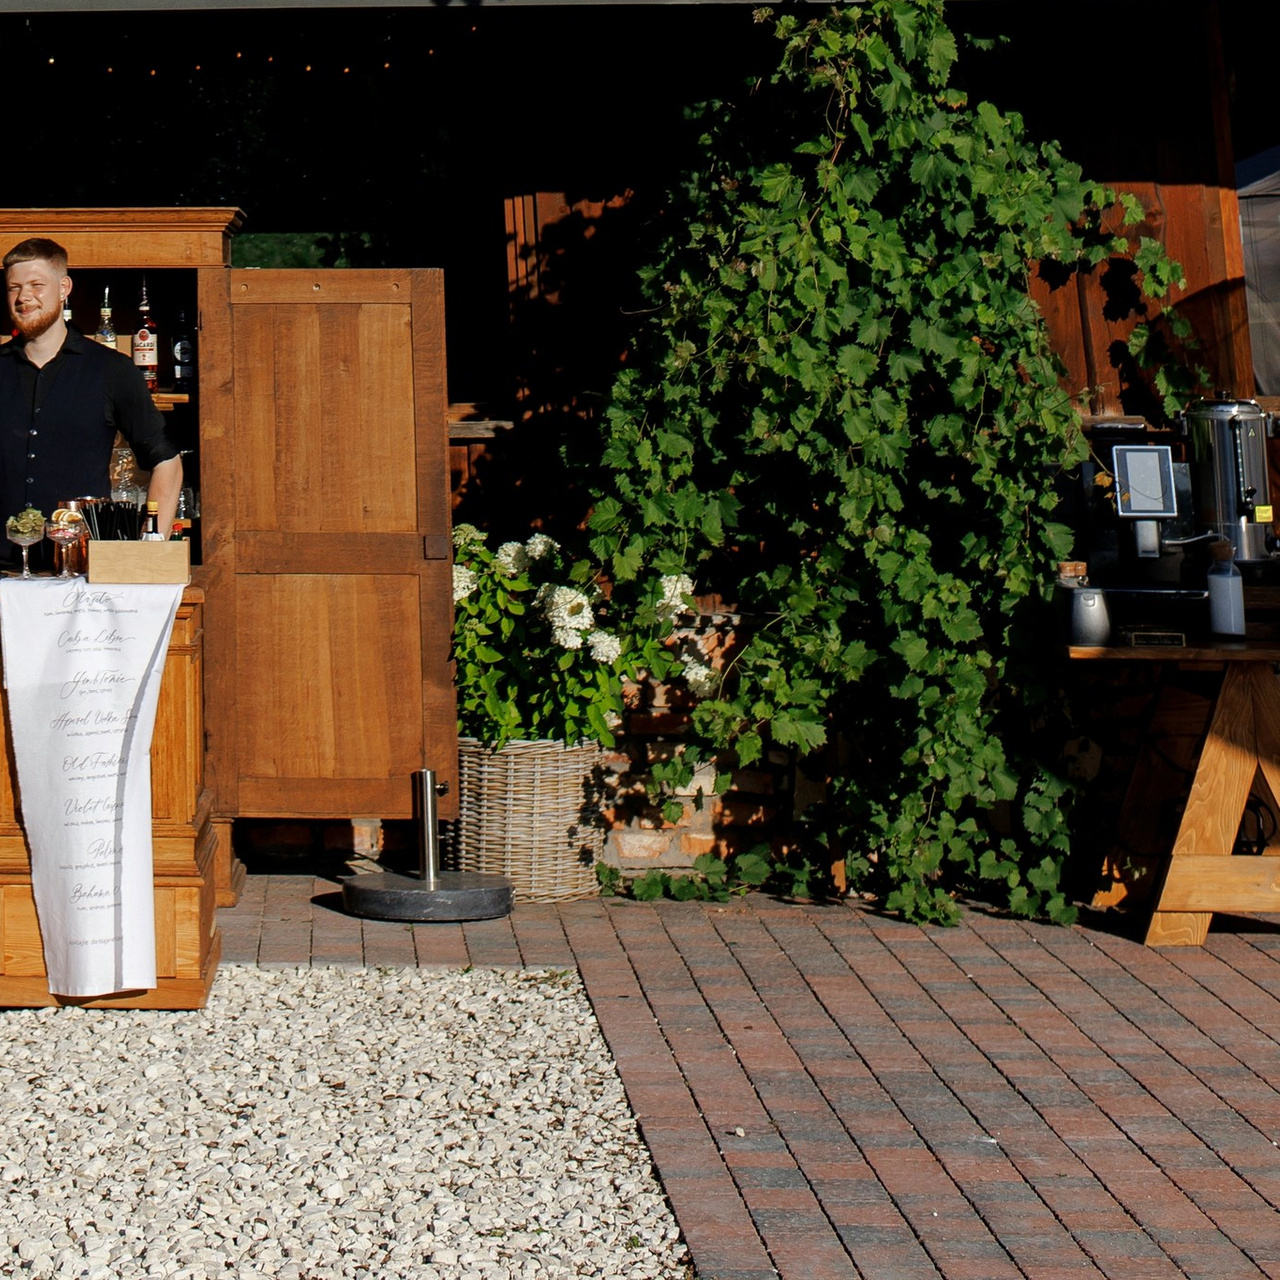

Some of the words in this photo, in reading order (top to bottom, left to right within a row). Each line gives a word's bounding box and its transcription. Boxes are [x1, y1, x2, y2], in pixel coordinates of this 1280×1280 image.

[57, 629, 89, 648] Cuba
[94, 628, 136, 644] Libre
[50, 710, 93, 731] Aperol
[62, 755, 90, 772] Old
[64, 798, 104, 816] Violet
